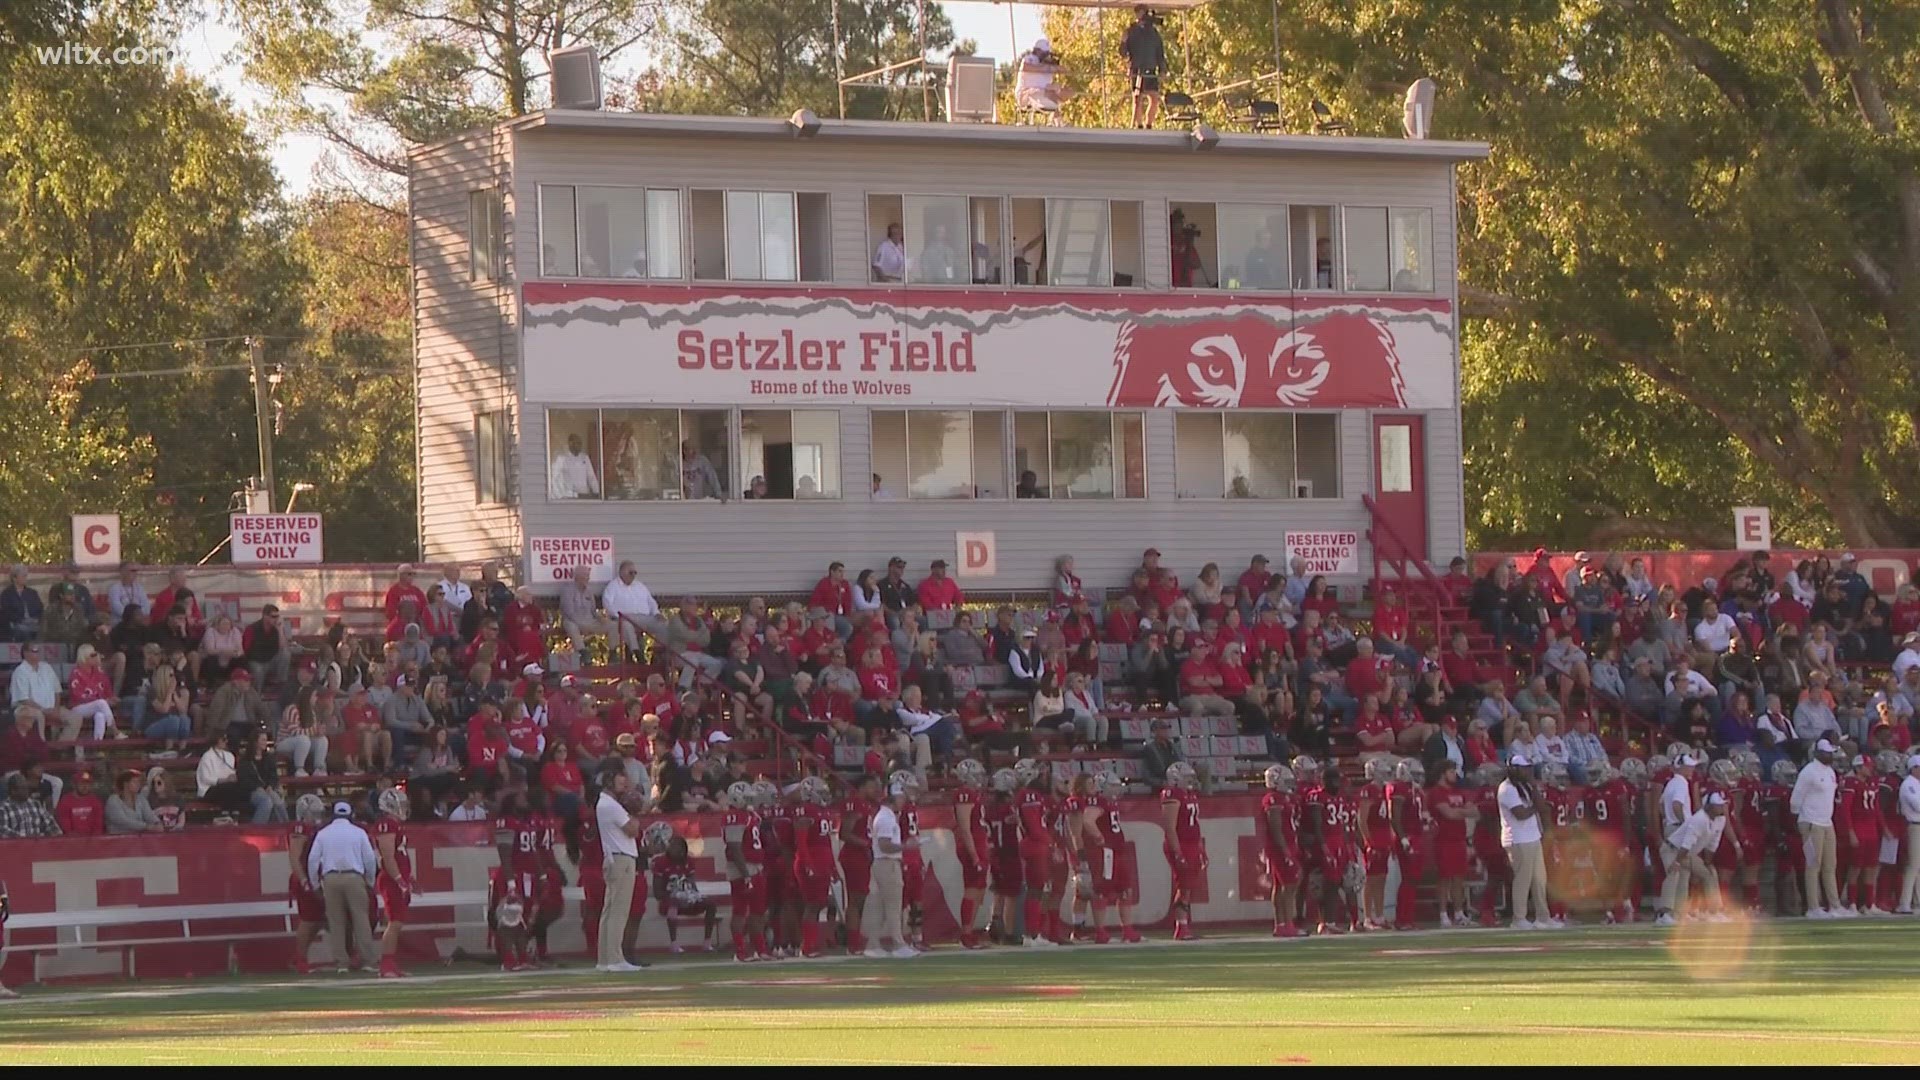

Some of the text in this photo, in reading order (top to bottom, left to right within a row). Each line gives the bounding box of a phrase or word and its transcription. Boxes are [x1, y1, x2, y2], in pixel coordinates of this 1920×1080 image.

[677, 329, 977, 372] Setzler Field
[750, 379, 911, 395] Home of the Wolves
[234, 517, 318, 530] RESERVED
[1744, 516, 1762, 541] E
[84, 524, 111, 556] C
[242, 531, 310, 545] SEATING
[1287, 534, 1356, 546] RESERVED
[256, 546, 297, 559] ONLY
[532, 539, 611, 552] RESERVED
[540, 553, 604, 566] SEATING
[966, 540, 988, 568] D
[1294, 547, 1349, 559] SEATING
[1306, 561, 1339, 572] ONLY
[483, 747, 495, 761] N
[1595, 799, 1607, 820] 9
